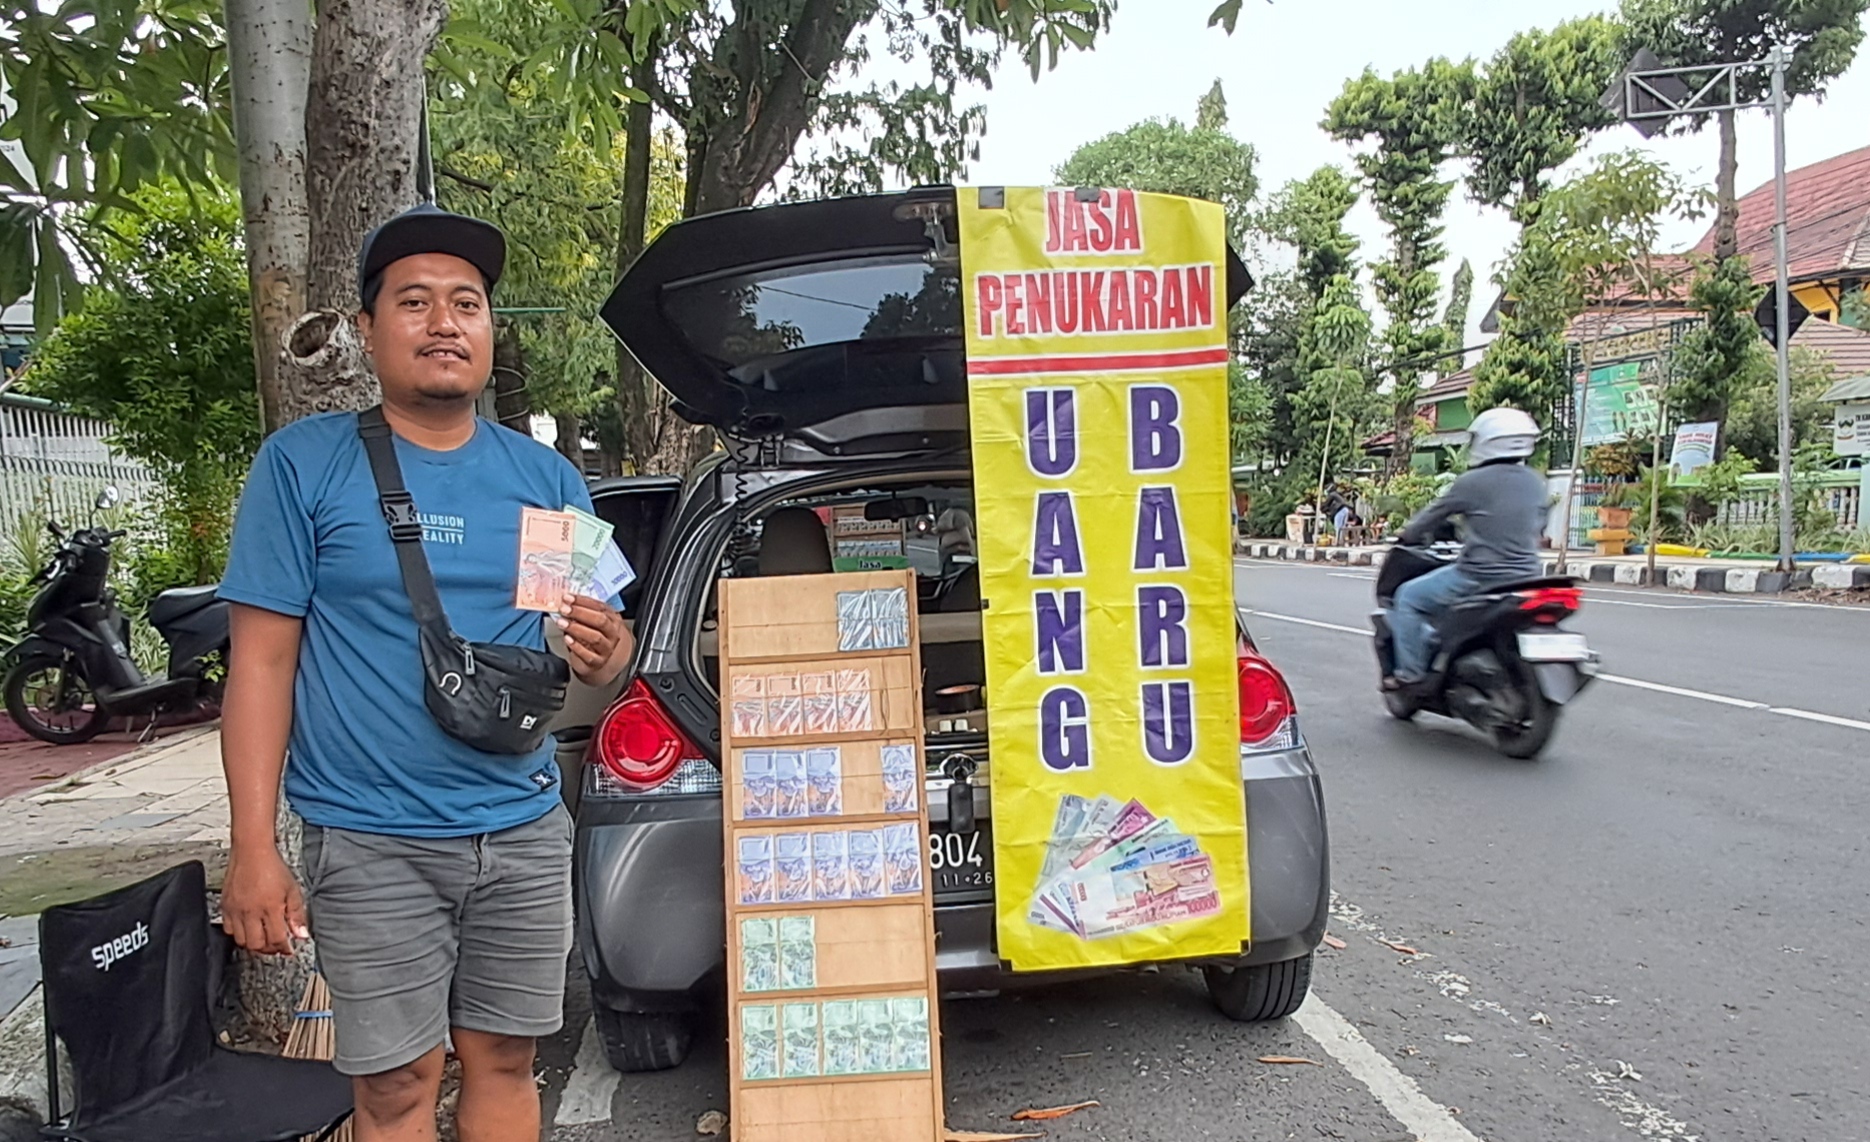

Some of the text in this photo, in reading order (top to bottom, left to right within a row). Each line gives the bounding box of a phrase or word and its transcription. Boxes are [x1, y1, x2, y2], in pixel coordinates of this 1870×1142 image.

[1045, 188, 1141, 252] JASA
[977, 265, 1212, 336] PENUKARAN
[416, 512, 464, 528] LLUSION
[421, 529, 464, 545] EALITY
[1025, 389, 1090, 771] UANG
[1129, 386, 1193, 763] BARU
[928, 831, 983, 869] 804
[91, 921, 149, 971] speeds
